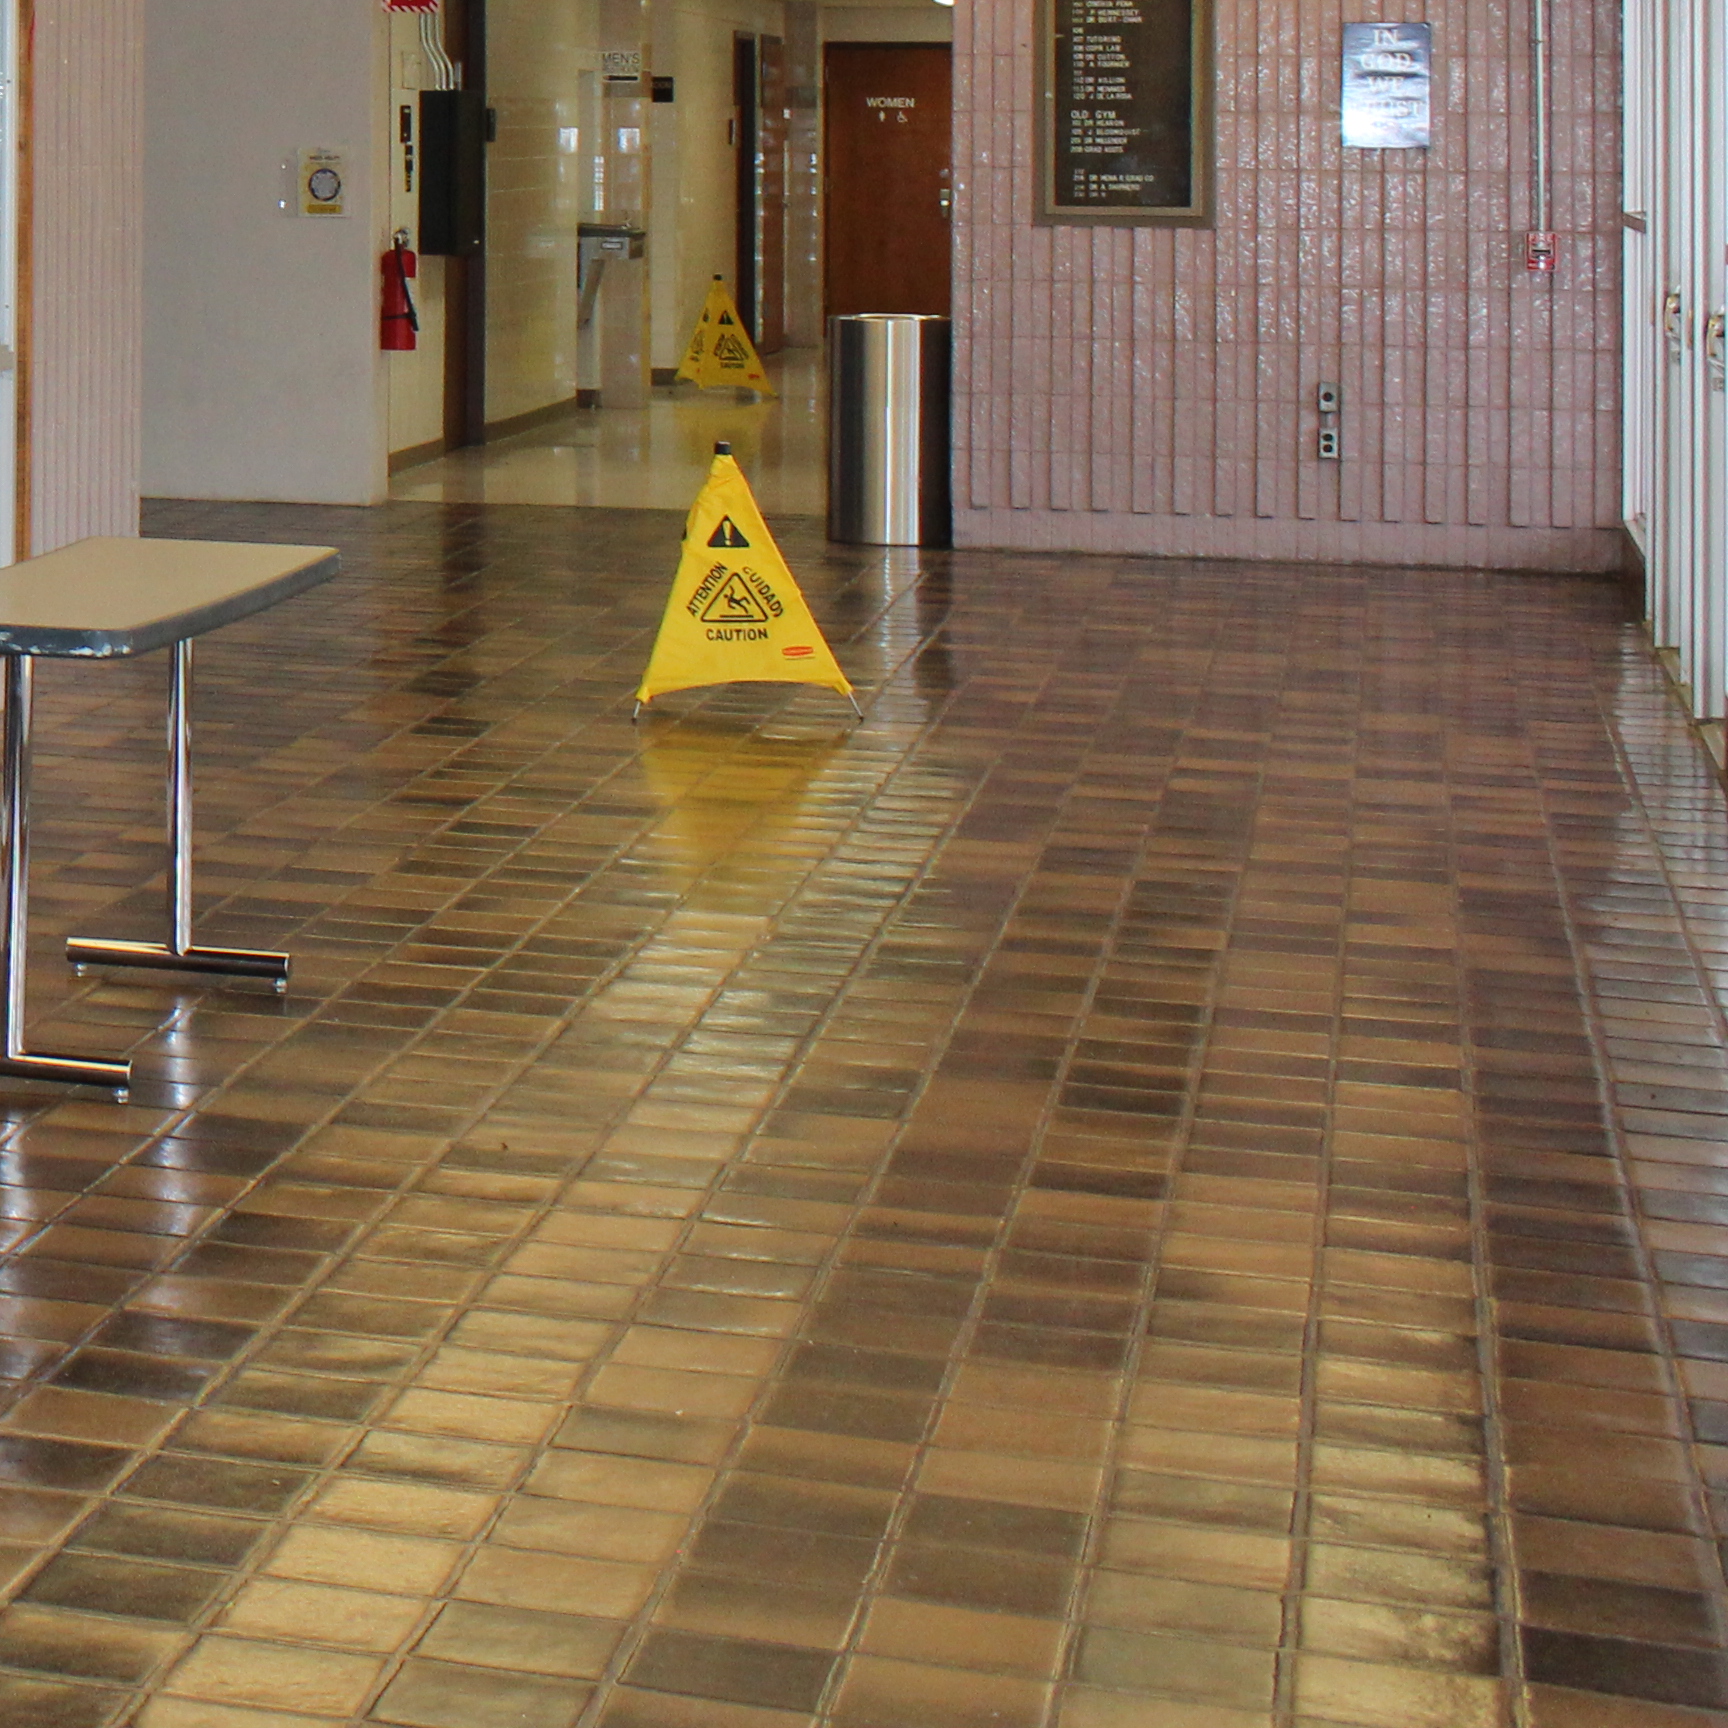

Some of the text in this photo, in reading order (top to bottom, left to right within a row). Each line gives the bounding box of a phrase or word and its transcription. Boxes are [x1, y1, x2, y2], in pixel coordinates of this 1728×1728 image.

[1372, 29, 1399, 46] IN
[1361, 52, 1413, 70] GOD
[1367, 75, 1404, 92] WE
[865, 97, 916, 108] WOMEN
[1070, 110, 1116, 120] OLD GYM
[686, 561, 728, 617] ATTENTION
[706, 628, 769, 642] CAUTION
